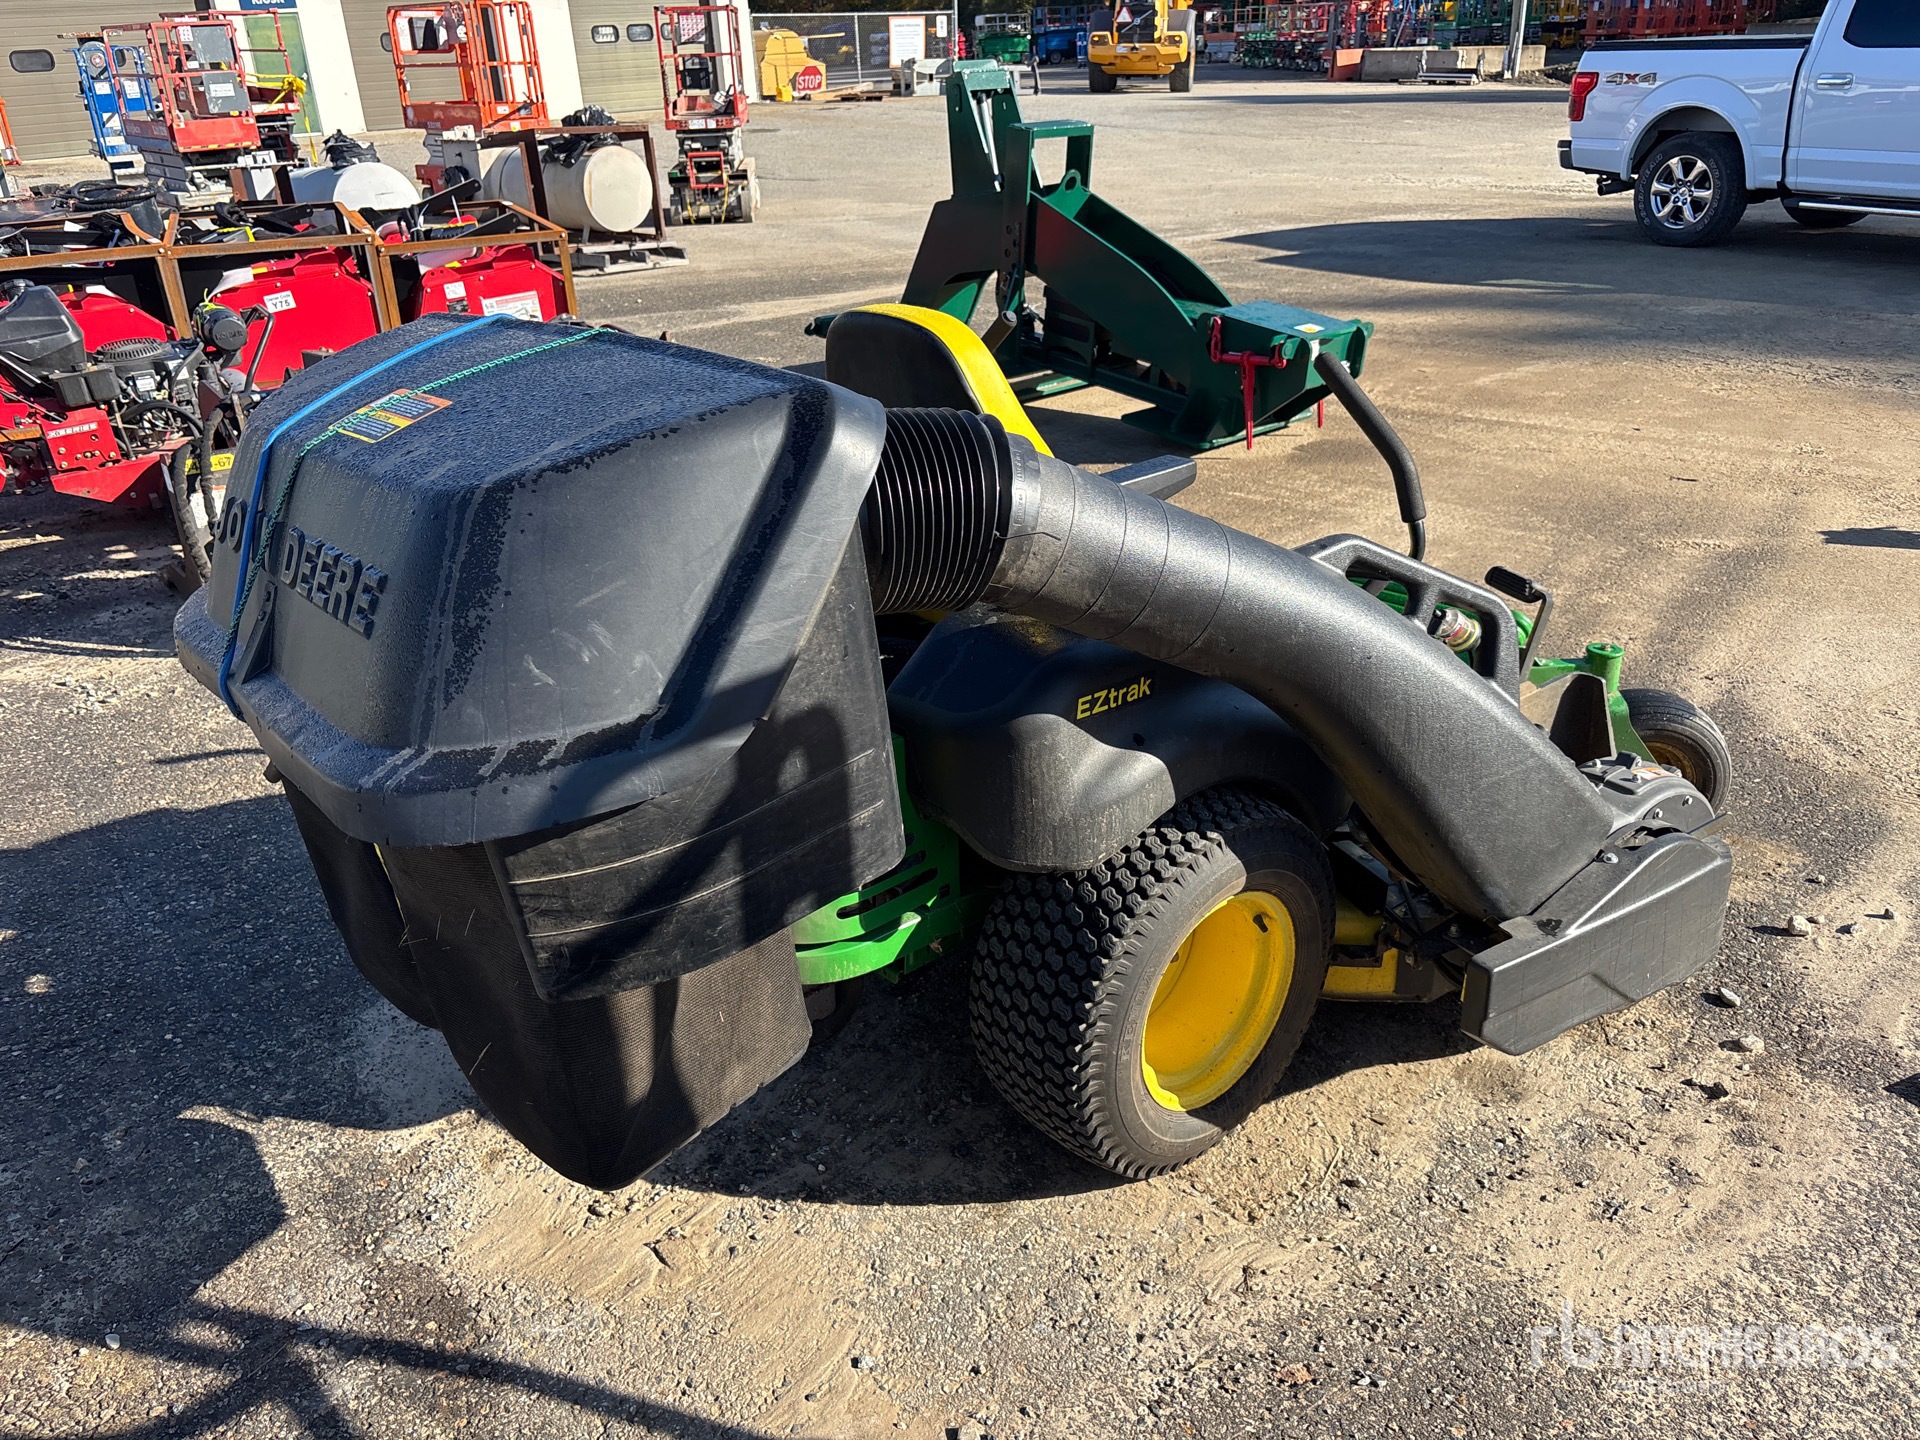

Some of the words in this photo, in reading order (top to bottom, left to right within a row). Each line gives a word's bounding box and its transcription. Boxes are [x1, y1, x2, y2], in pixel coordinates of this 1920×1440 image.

[798, 74, 822, 89] STOP
[280, 526, 387, 638] DEERE
[1076, 676, 1152, 720] EZtrak
